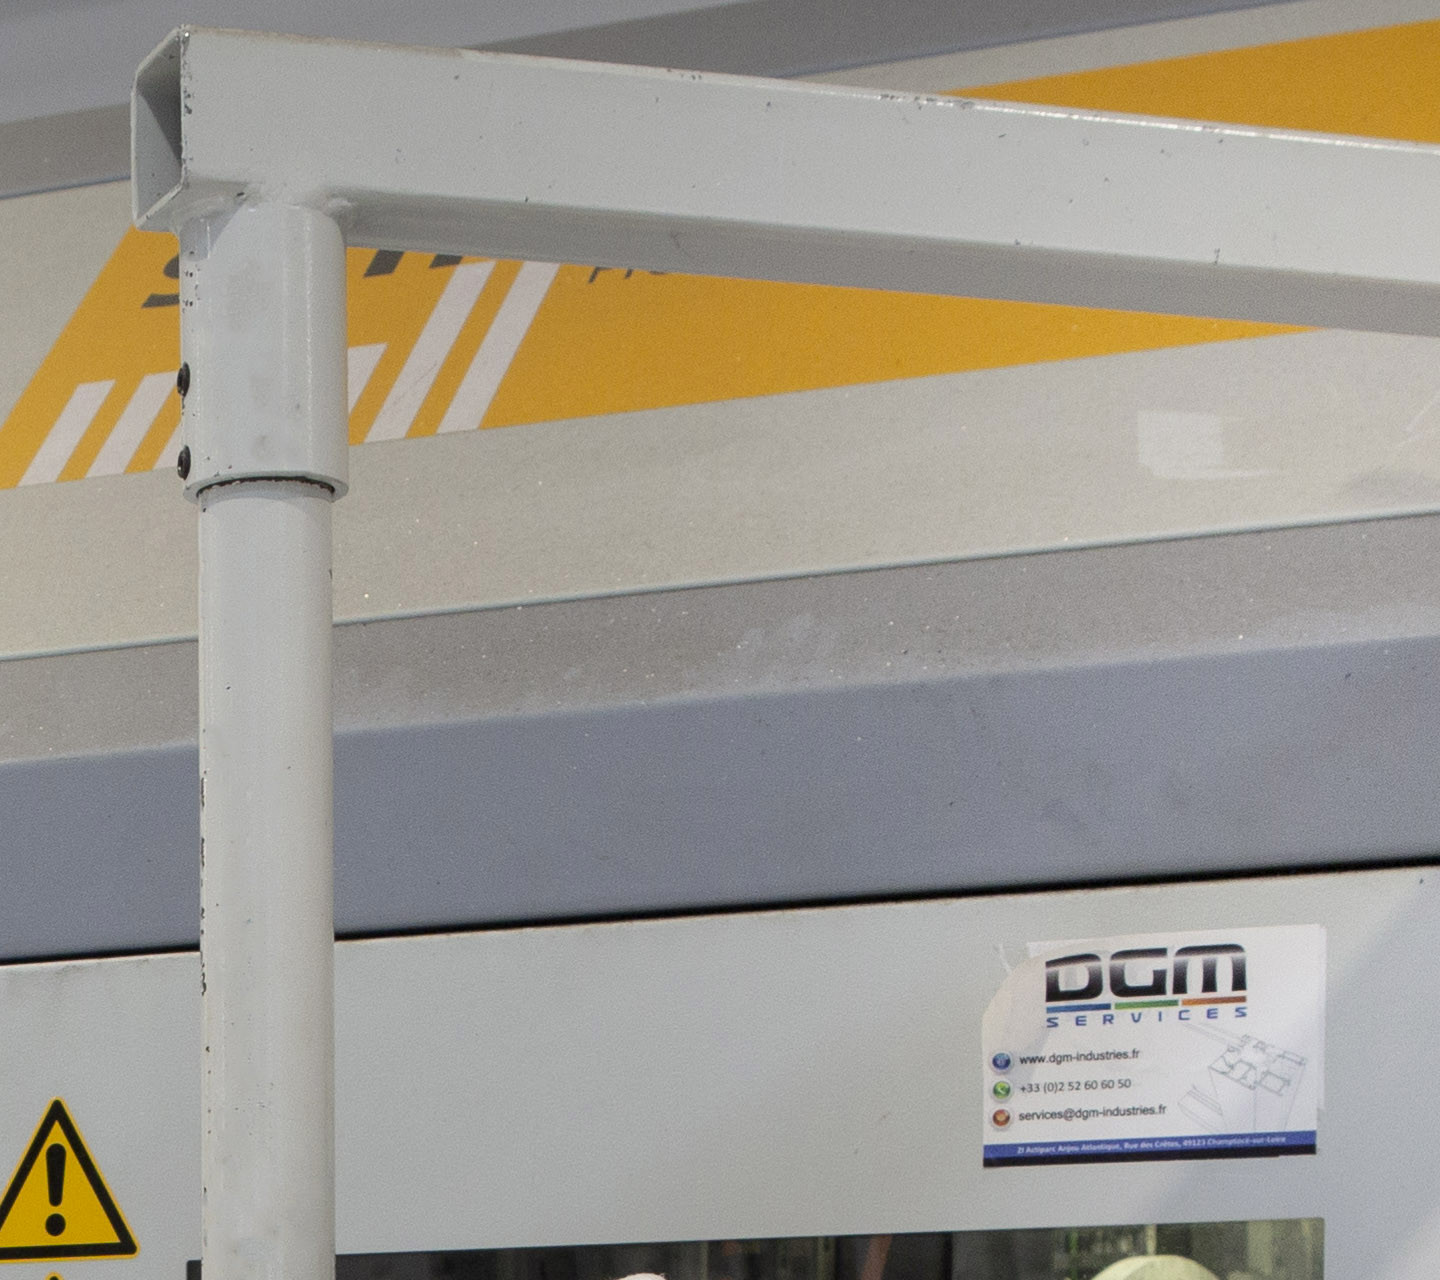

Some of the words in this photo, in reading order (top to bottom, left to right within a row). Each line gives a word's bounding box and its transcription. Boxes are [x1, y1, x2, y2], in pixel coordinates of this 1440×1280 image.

[1045, 943, 1247, 1003] DGM
[1046, 1007, 1248, 1028] SERVICES
[1019, 1049, 1140, 1065] www.dgm-industries.fr
[1020, 1083, 1039, 1094] +33
[1043, 1082, 1065, 1095] (0)2
[1068, 1081, 1081, 1091] 52
[1084, 1080, 1098, 1090] 60
[1101, 1079, 1115, 1090] 60
[1118, 1078, 1131, 1089] 50
[1018, 1104, 1167, 1122] services@dgm-industries.fr
